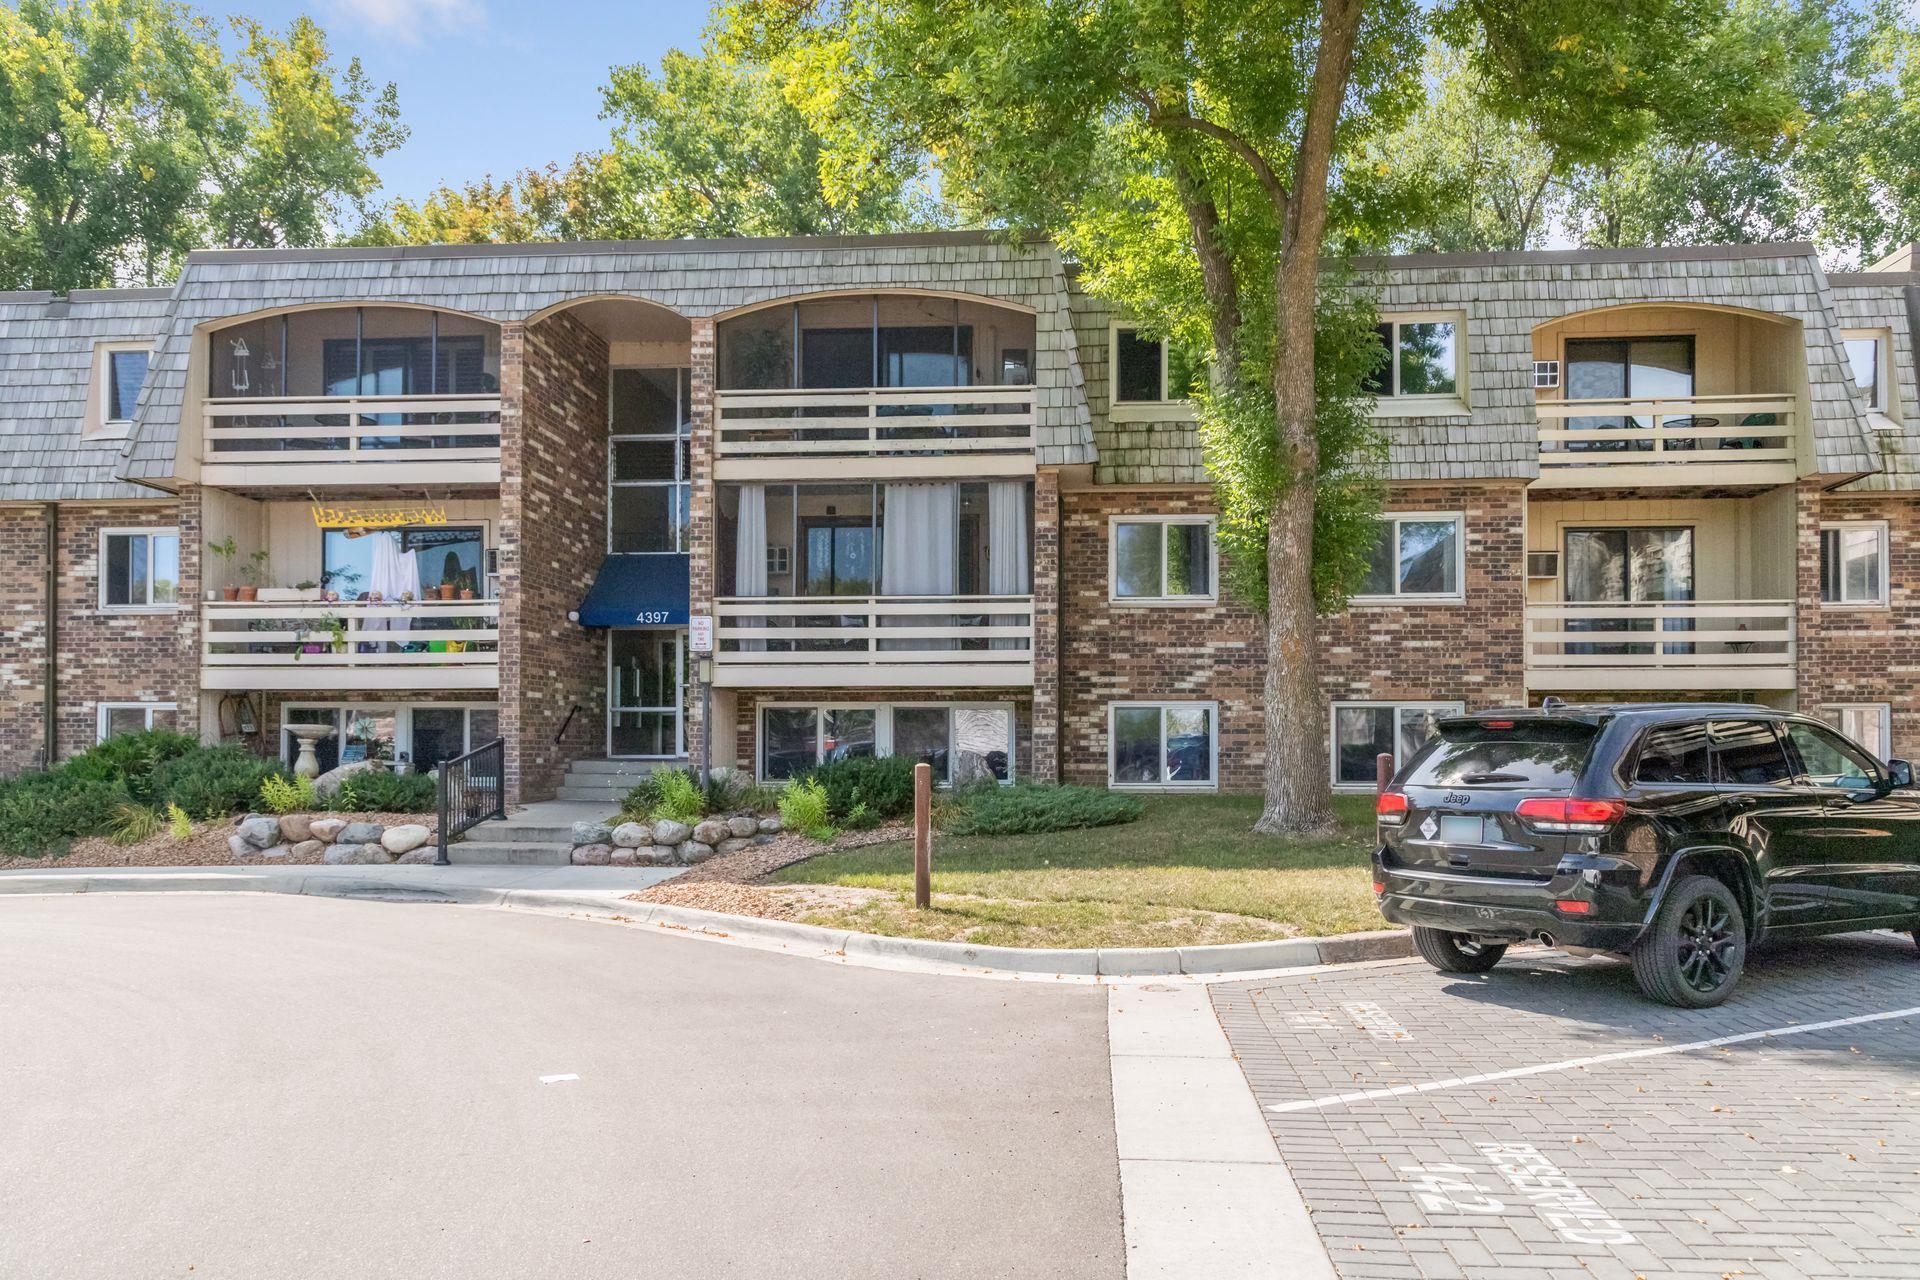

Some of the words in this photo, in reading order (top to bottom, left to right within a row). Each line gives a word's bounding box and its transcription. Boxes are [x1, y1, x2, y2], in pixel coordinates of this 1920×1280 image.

[636, 611, 669, 624] 4397
[1443, 792, 1470, 806] Jeep
[1399, 1162, 1505, 1213] 142
[1474, 1141, 1637, 1245] RESERVED
